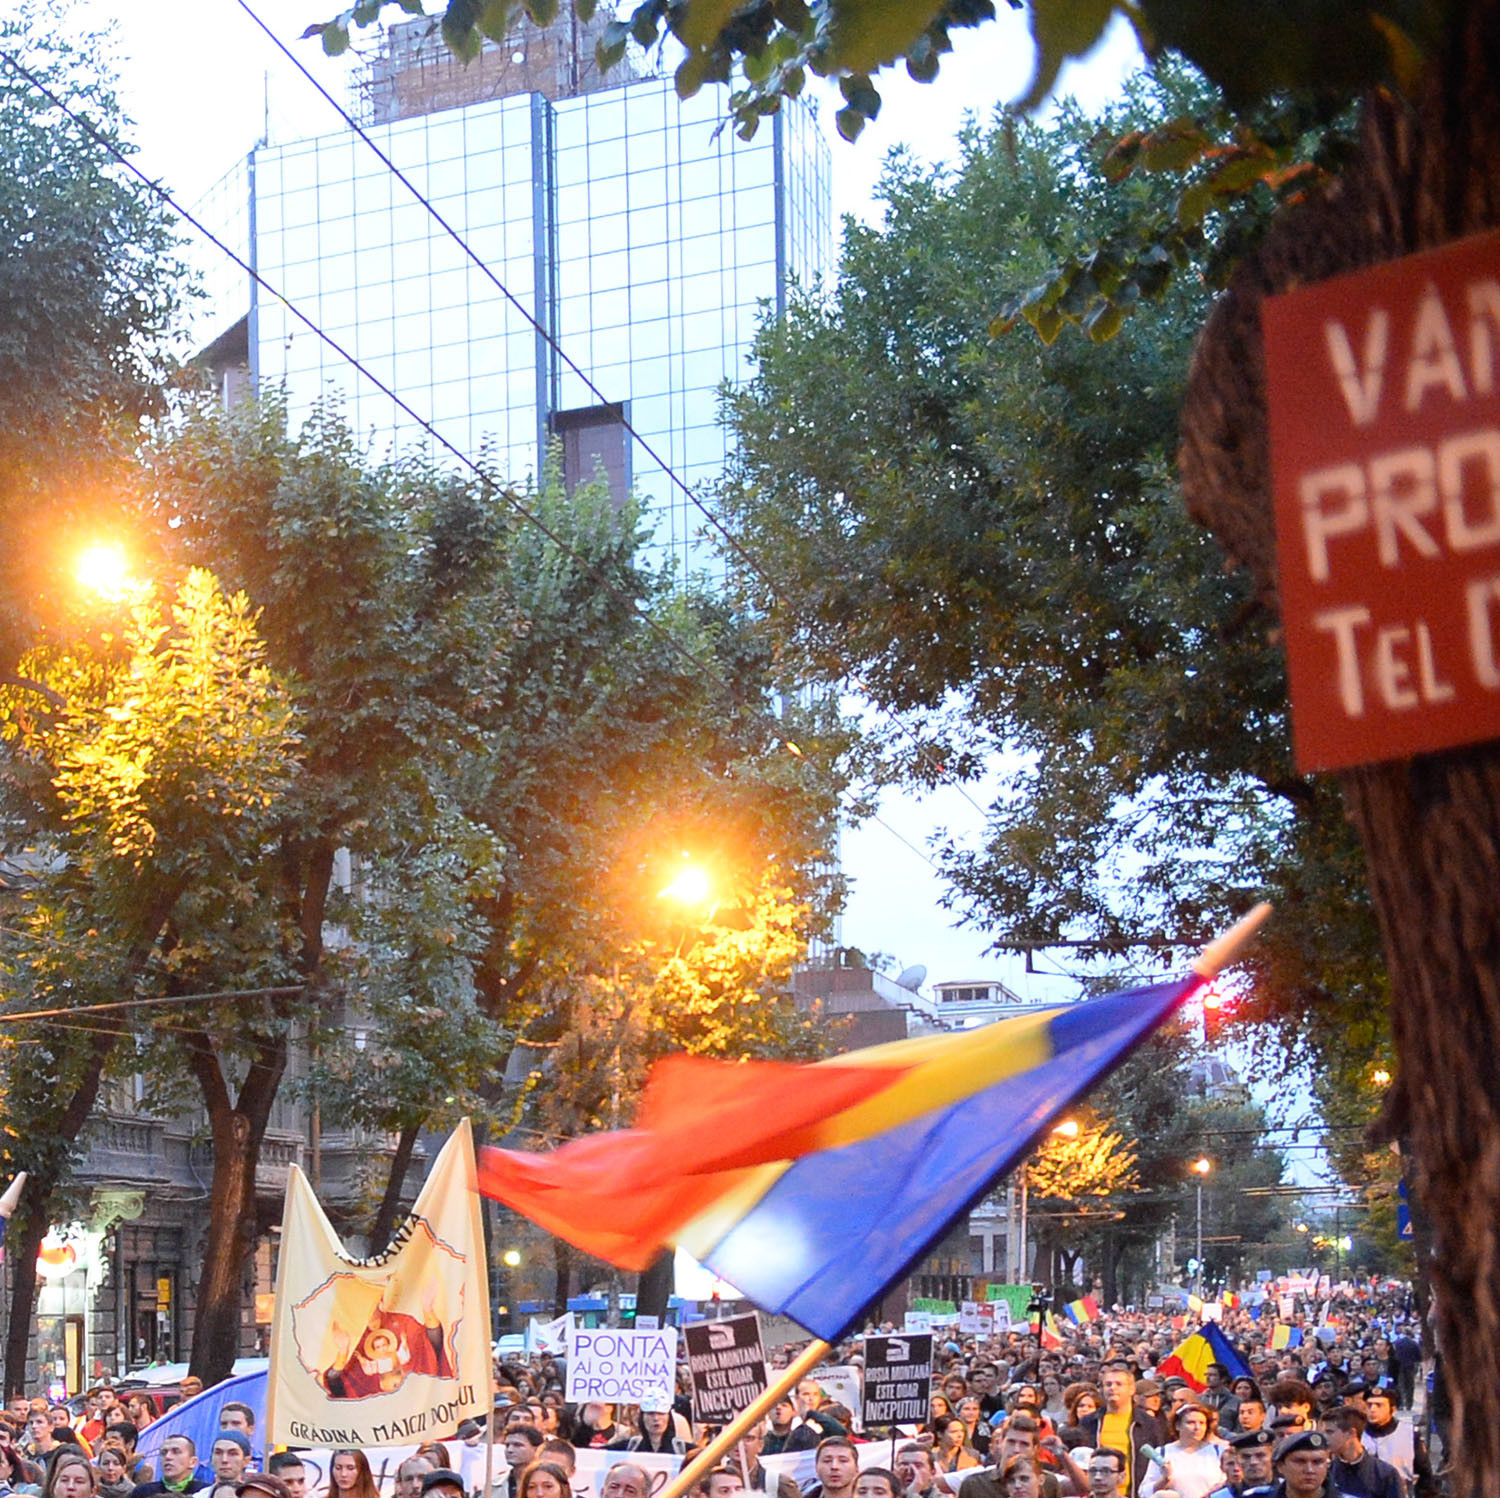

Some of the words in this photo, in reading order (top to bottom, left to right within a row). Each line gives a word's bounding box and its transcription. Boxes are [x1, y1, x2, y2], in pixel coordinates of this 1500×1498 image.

[574, 1334, 670, 1359] PONTA
[599, 1361, 613, 1376] O
[876, 1383, 895, 1400] ESTE
[896, 1383, 919, 1399] DOAR
